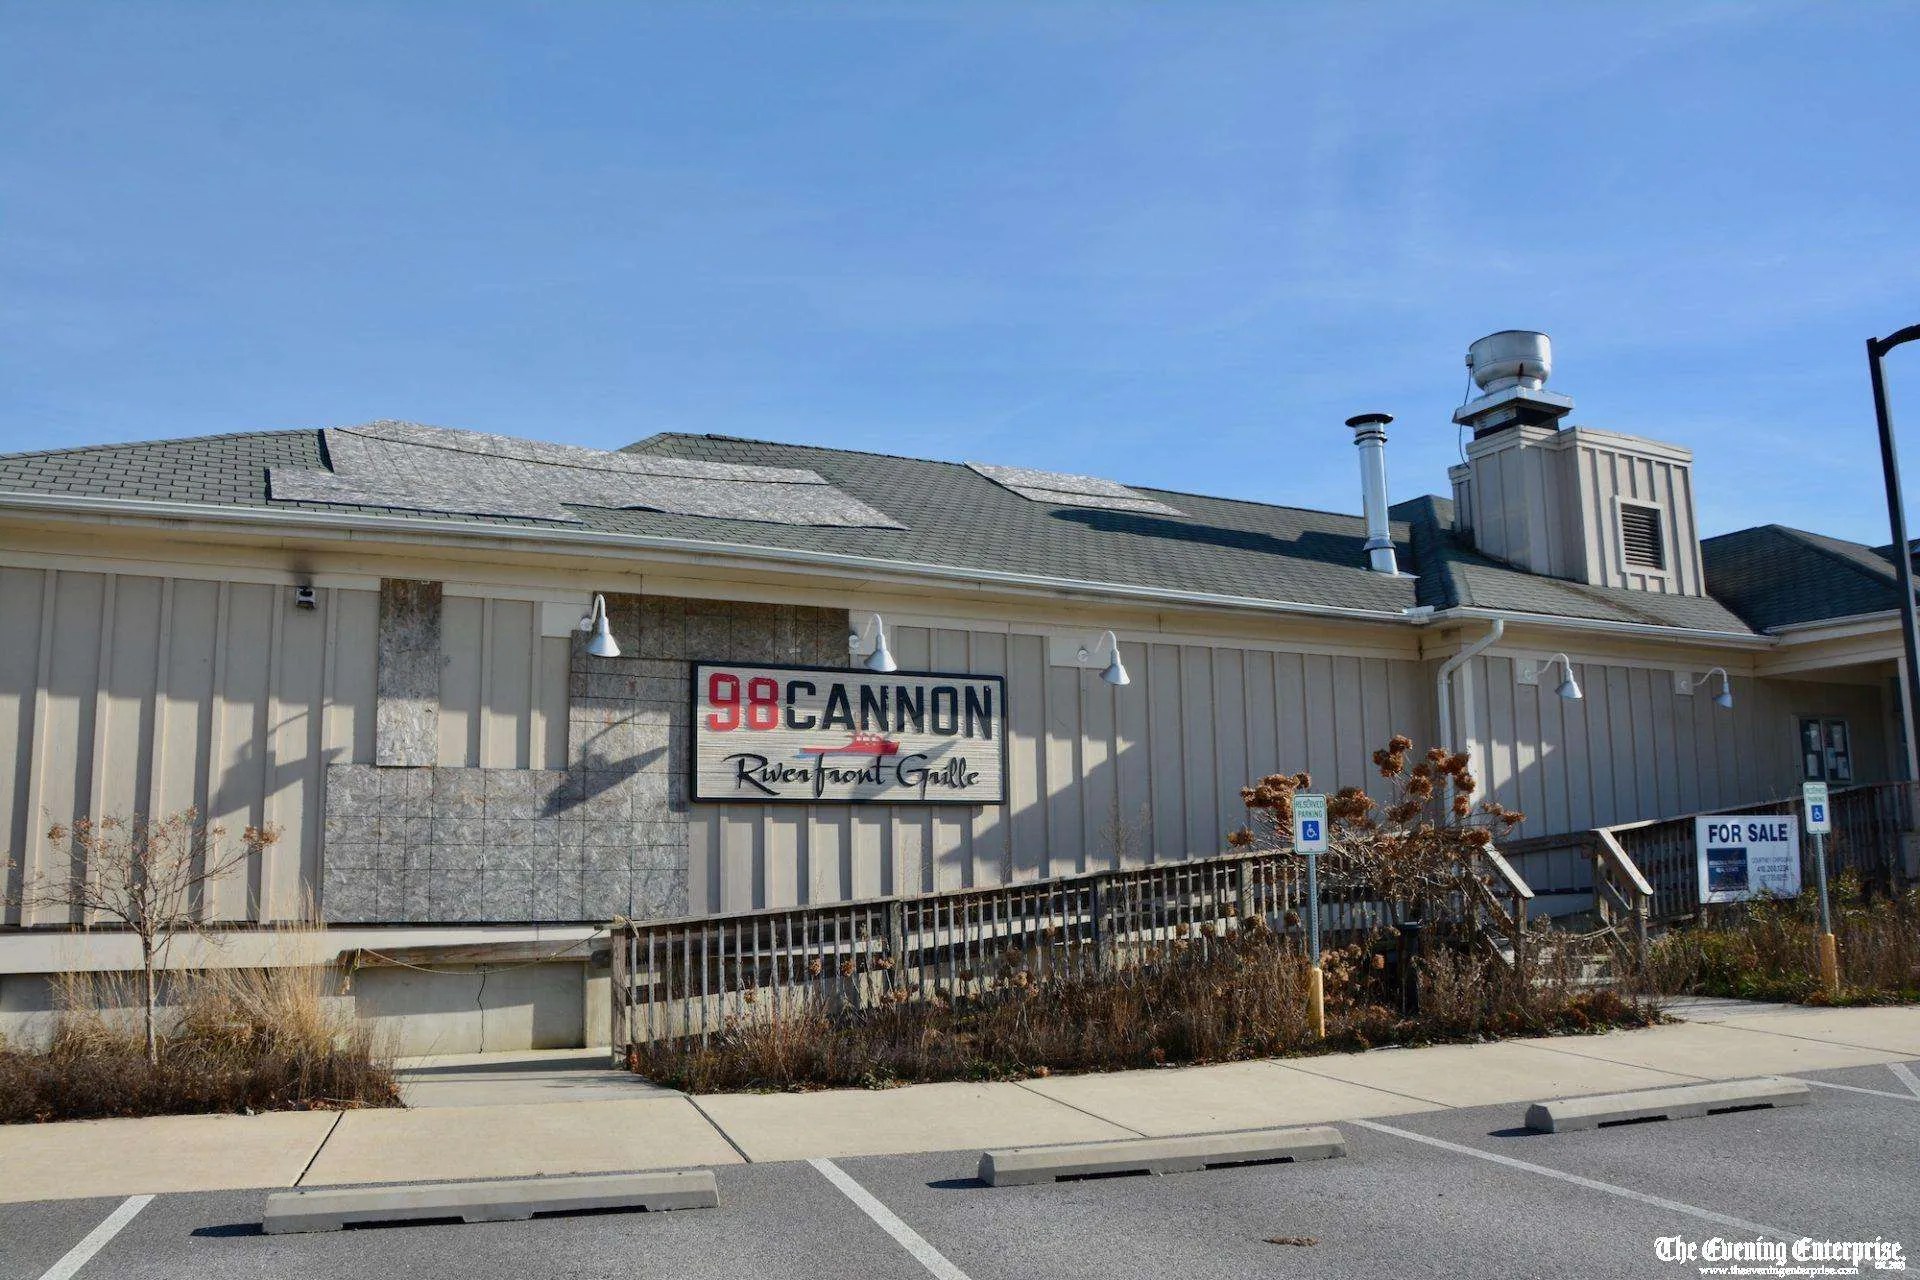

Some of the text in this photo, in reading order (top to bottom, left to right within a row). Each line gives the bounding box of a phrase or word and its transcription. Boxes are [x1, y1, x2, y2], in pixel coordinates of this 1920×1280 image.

[786, 680, 993, 740] CANNON
[896, 753, 980, 800] Grille
[1708, 823, 1788, 843] FOR SALE
